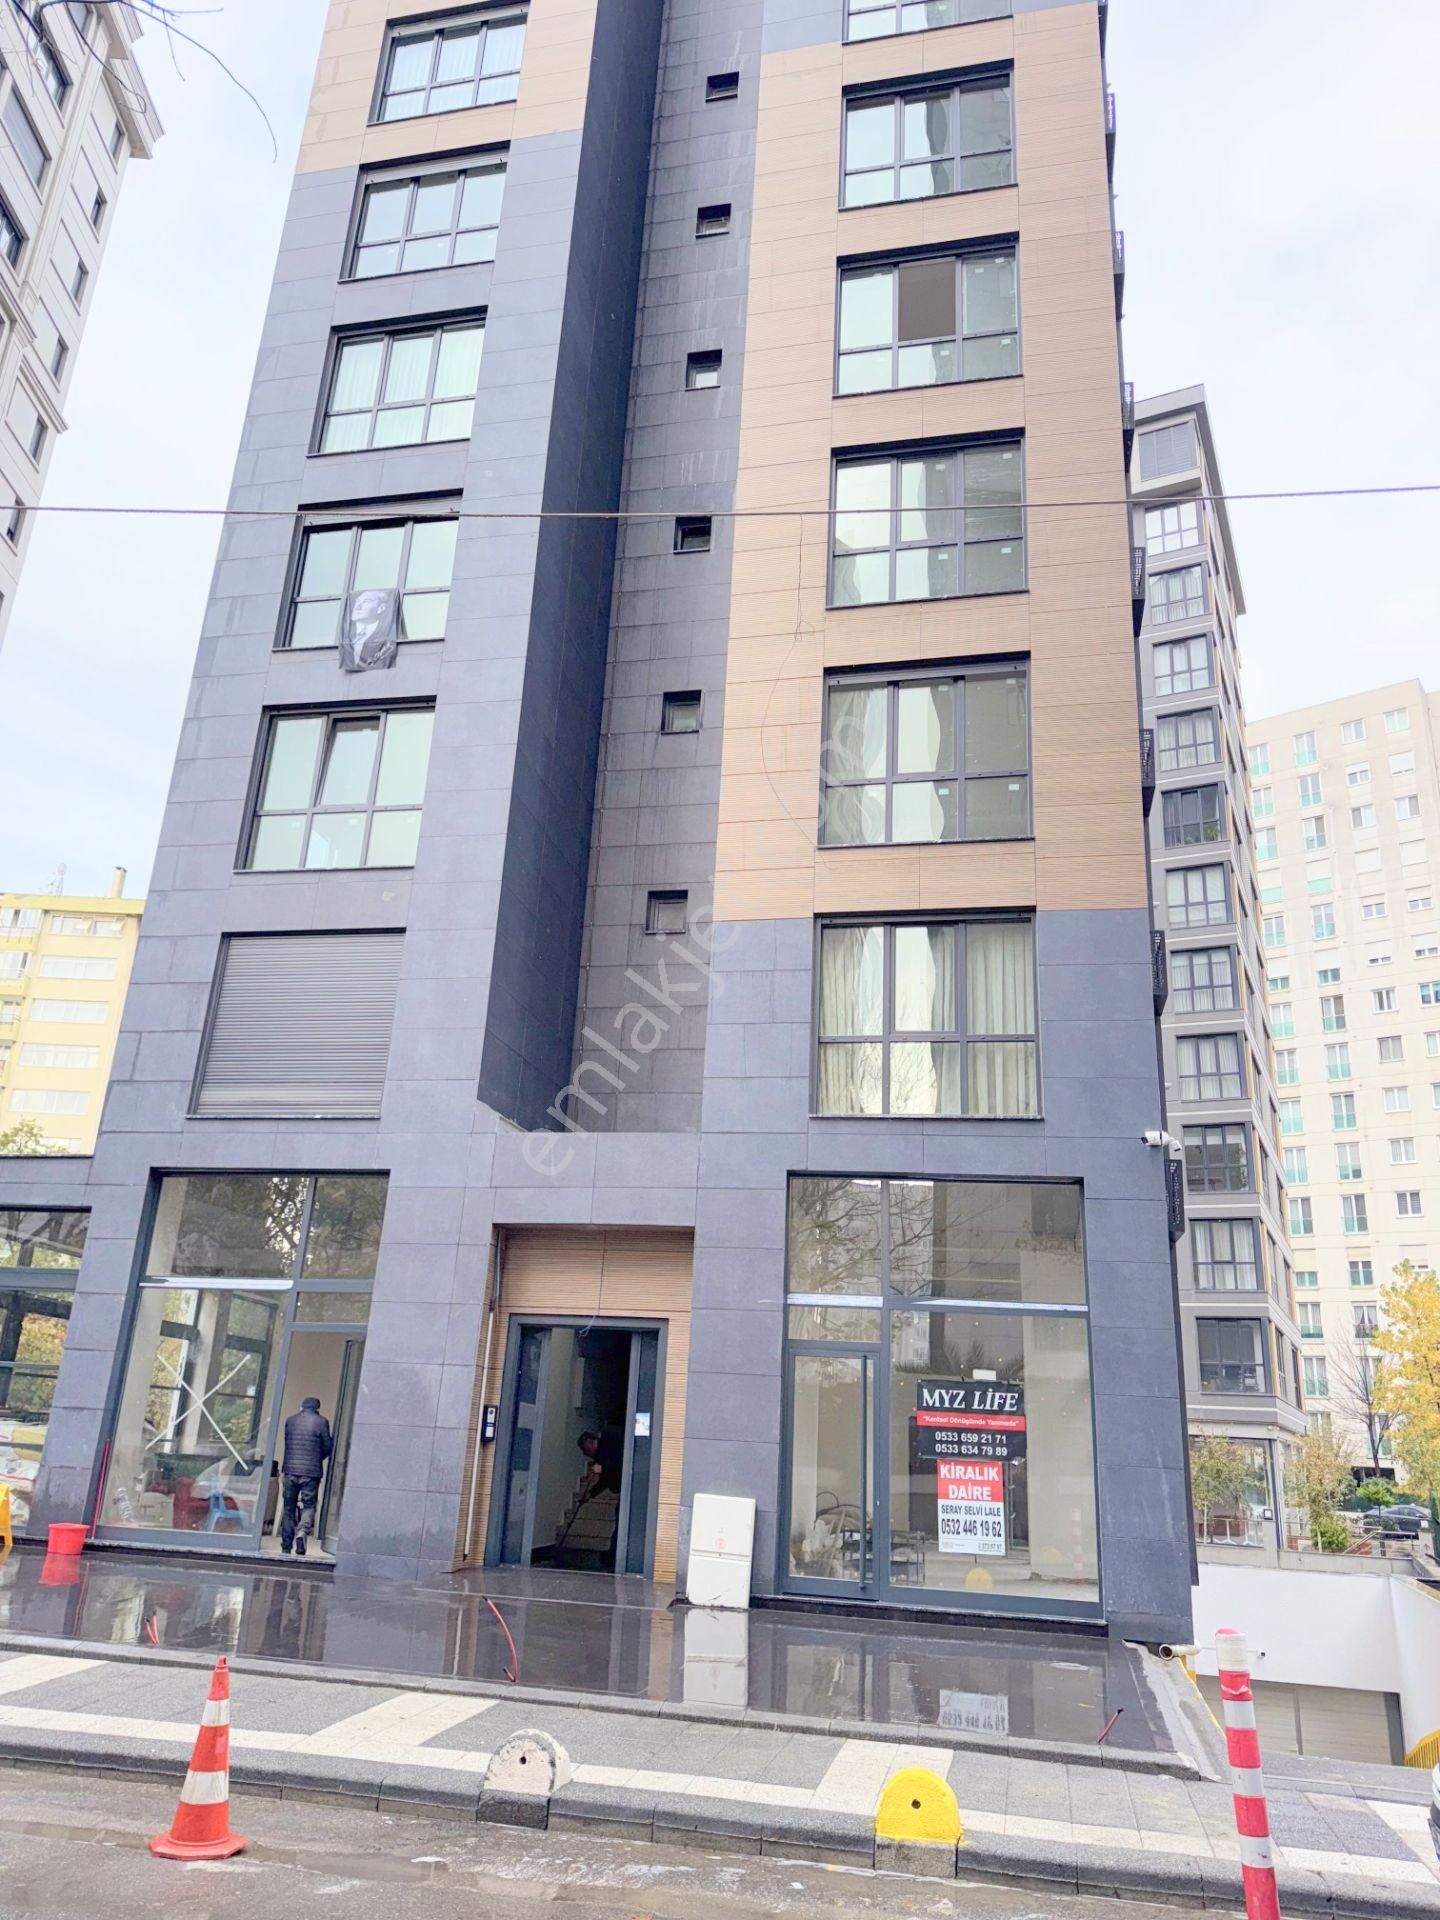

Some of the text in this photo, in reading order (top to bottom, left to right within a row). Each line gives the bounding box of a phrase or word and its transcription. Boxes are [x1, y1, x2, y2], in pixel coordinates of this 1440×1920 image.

[922, 1388, 1019, 1411] MYZ LİFE
[935, 1431, 1007, 1445] 0533 659 21 71
[935, 1443, 1008, 1457] 0533 634 79 89
[940, 1462, 999, 1481] KİRALIK
[949, 1482, 992, 1500] DAİRE
[941, 1503, 1001, 1517] SERAY SELVİ LALE
[941, 1518, 1002, 1538] 0532 446 19 62
